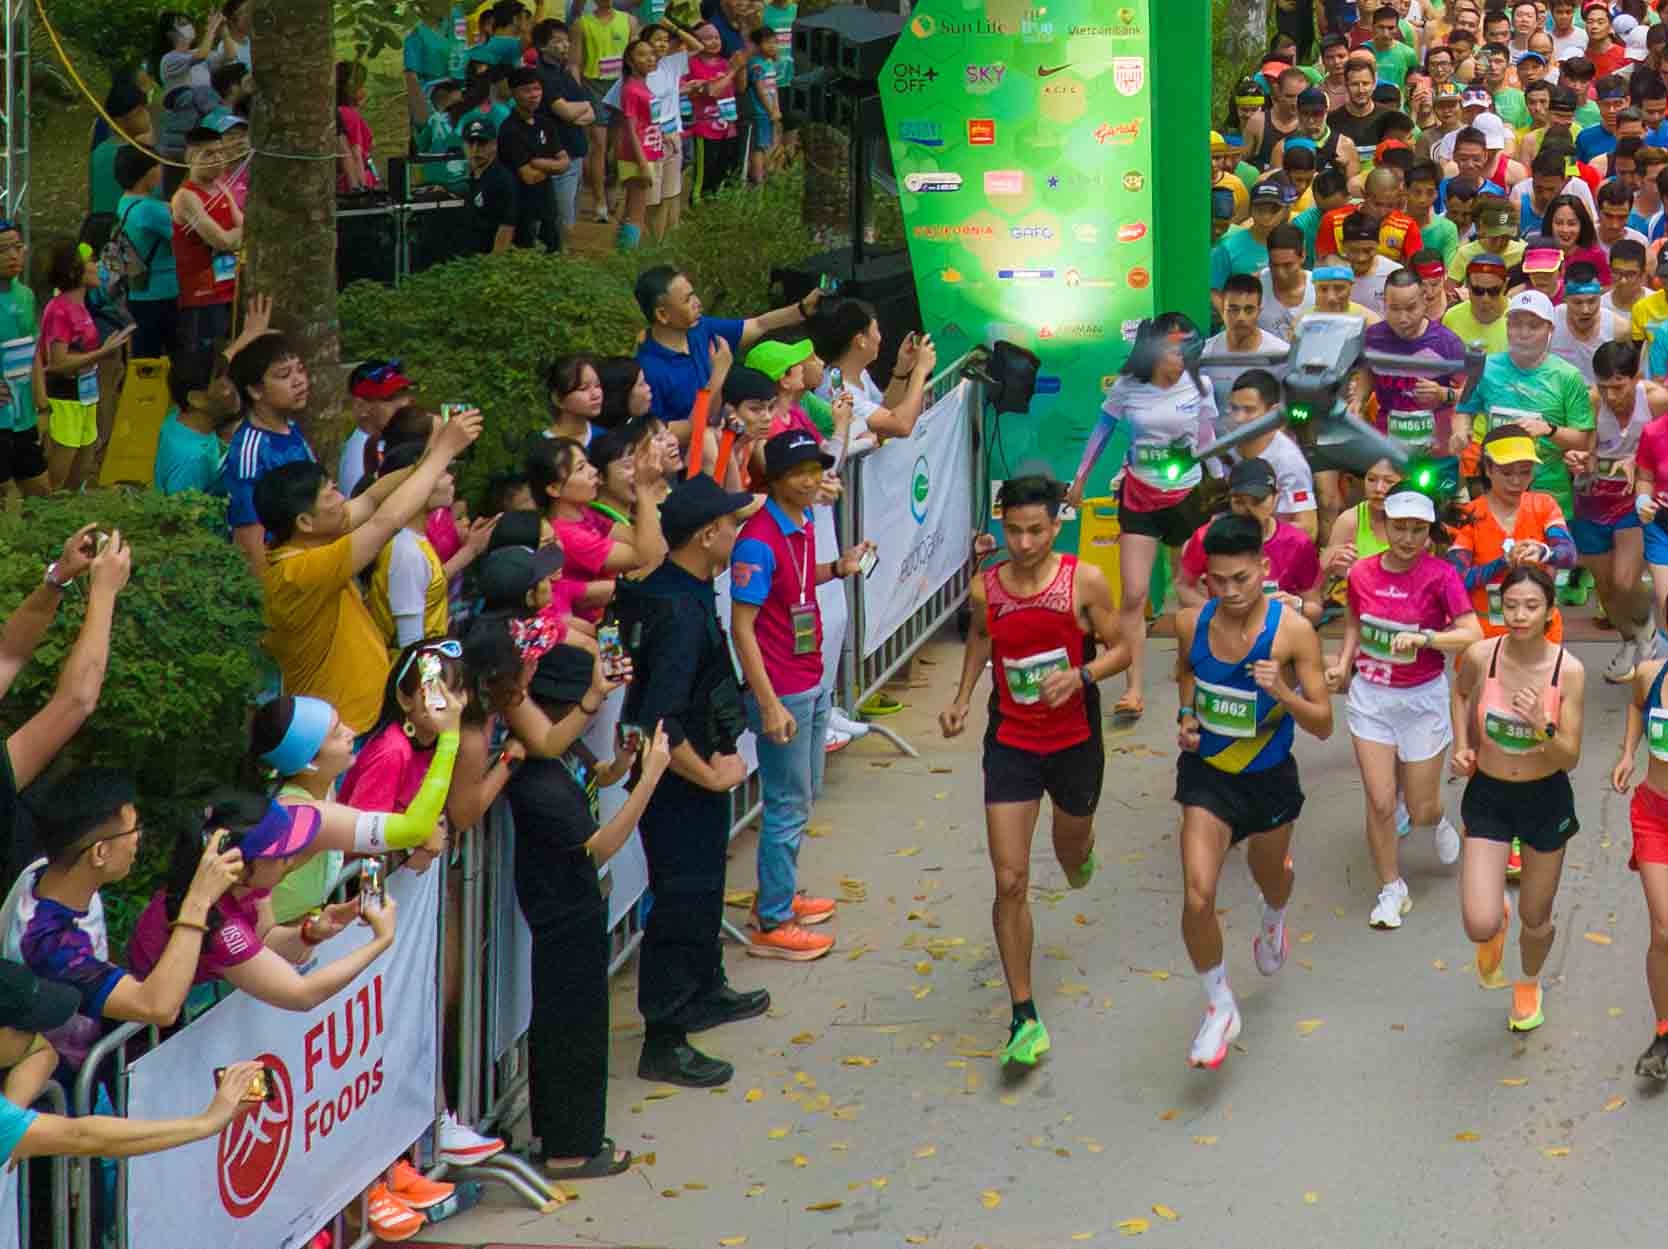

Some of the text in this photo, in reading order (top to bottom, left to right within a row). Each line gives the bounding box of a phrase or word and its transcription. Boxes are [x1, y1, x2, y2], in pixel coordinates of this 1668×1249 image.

[941, 20, 970, 33] Sun
[893, 64, 921, 78] ON
[966, 65, 1006, 83] SKY
[894, 79, 926, 93] OFF
[304, 975, 383, 1093] FUJI
